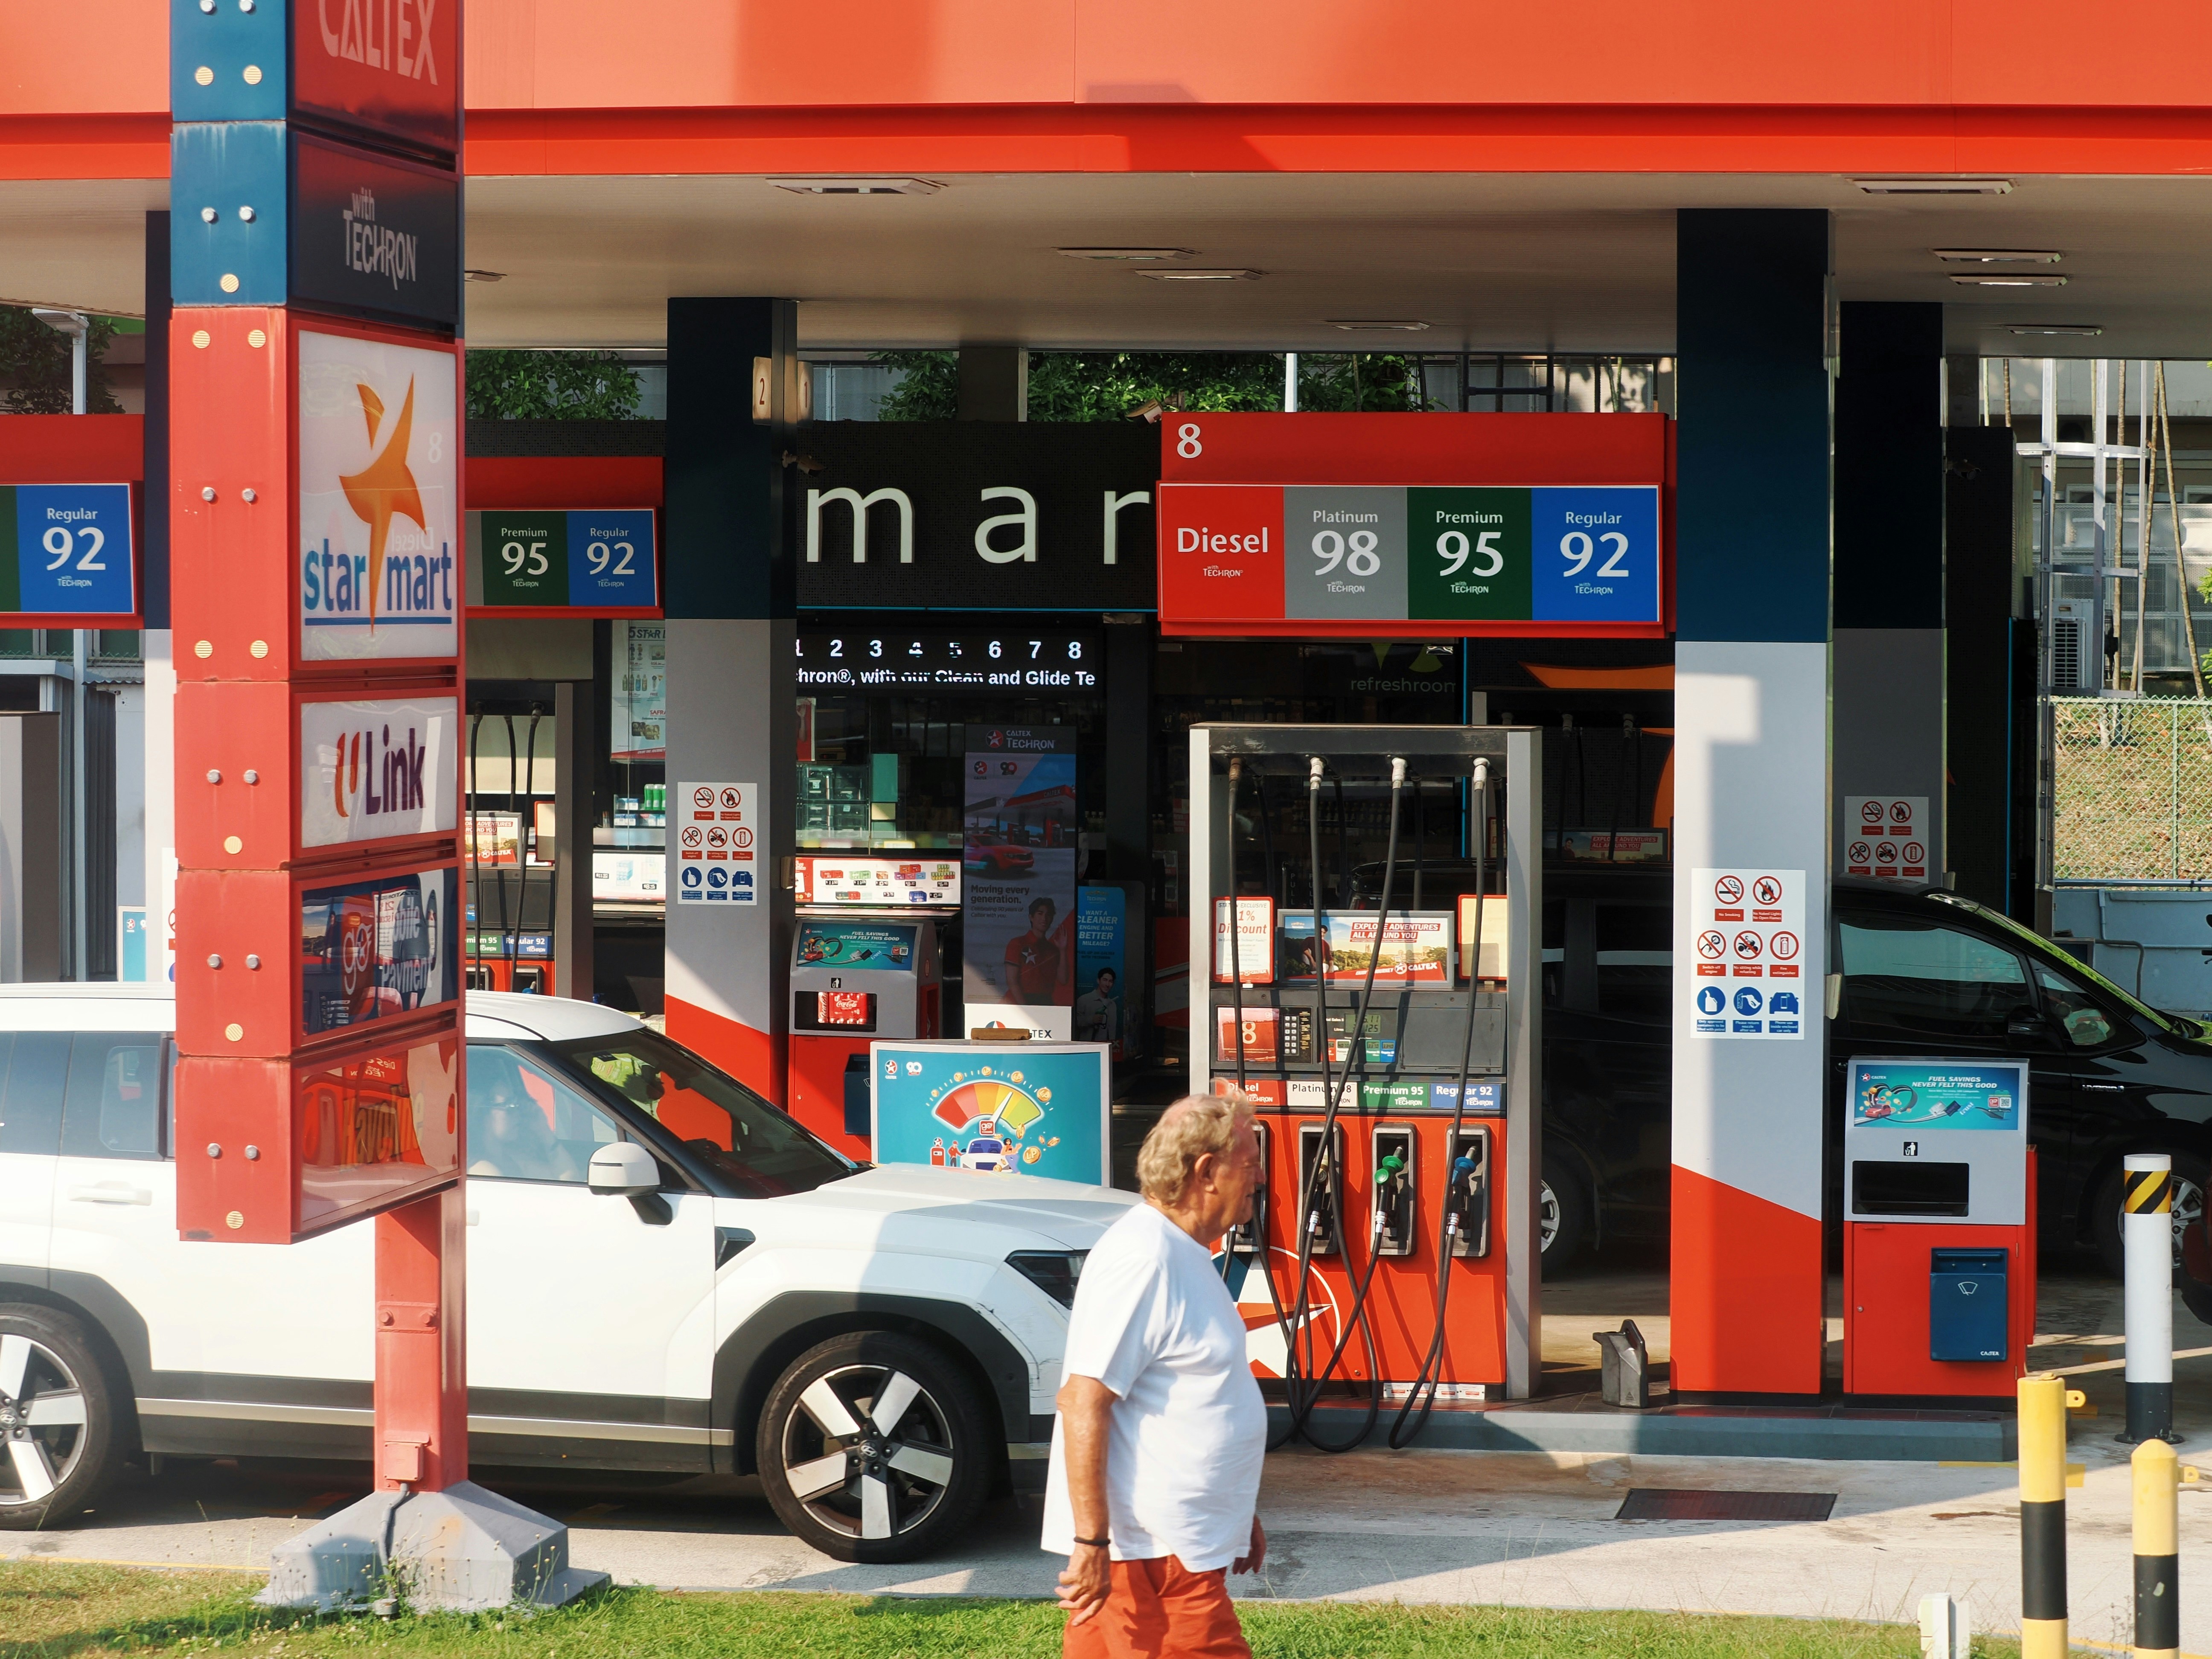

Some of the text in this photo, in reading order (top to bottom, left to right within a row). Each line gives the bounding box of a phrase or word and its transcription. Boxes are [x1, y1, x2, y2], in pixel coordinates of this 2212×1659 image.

[352, 187, 375, 221] with
[343, 210, 416, 290] TECHRON
[759, 378, 765, 405] 2
[804, 381, 808, 407] 1
[1177, 423, 1202, 459] 8
[47, 508, 98, 523] Regular
[1313, 510, 1378, 523] Platinum
[1436, 511, 1503, 523] Premium
[1566, 512, 1622, 527] Regular
[501, 528, 547, 537] Premium
[591, 528, 629, 539] Regular
[1178, 527, 1268, 553] Diesel
[43, 527, 106, 570] 92
[1312, 530, 1380, 576] 98
[1436, 531, 1503, 577] 95
[1560, 532, 1629, 577] 92
[502, 542, 548, 575] 95
[587, 542, 635, 575] 92
[304, 538, 452, 611] star mart
[57, 579, 92, 588] TECHRON
[1327, 584, 1365, 594] TECHRON
[1450, 585, 1489, 594] TECHRON
[1575, 586, 1613, 596] TECHRON
[830, 640, 843, 657] 2
[869, 640, 882, 657] 3
[988, 641, 1001, 658] 6
[1029, 641, 1042, 658] 7
[1068, 642, 1082, 659] 8
[861, 669, 896, 683] with
[988, 671, 1020, 685] and
[1026, 671, 1070, 685] Glide
[1075, 671, 1095, 685] Te
[1006, 738, 1054, 750] TECHRON
[971, 885, 1030, 895] Moving every
[971, 895, 1022, 904] generation.
[1077, 915, 1118, 924] CLEANER
[1218, 923, 1267, 934] Dicount
[1079, 931, 1113, 940] BETTER
[1408, 962, 1438, 971] CALTEX
[1029, 1030, 1051, 1038] TEX
[1242, 1022, 1257, 1044] 8
[906, 1062, 922, 1073] 90
[1228, 1083, 1259, 1092] Disel
[1363, 1086, 1423, 1095] Premium 95
[1479, 1086, 1492, 1095] 92
[1026, 1150, 1037, 1160] LP
